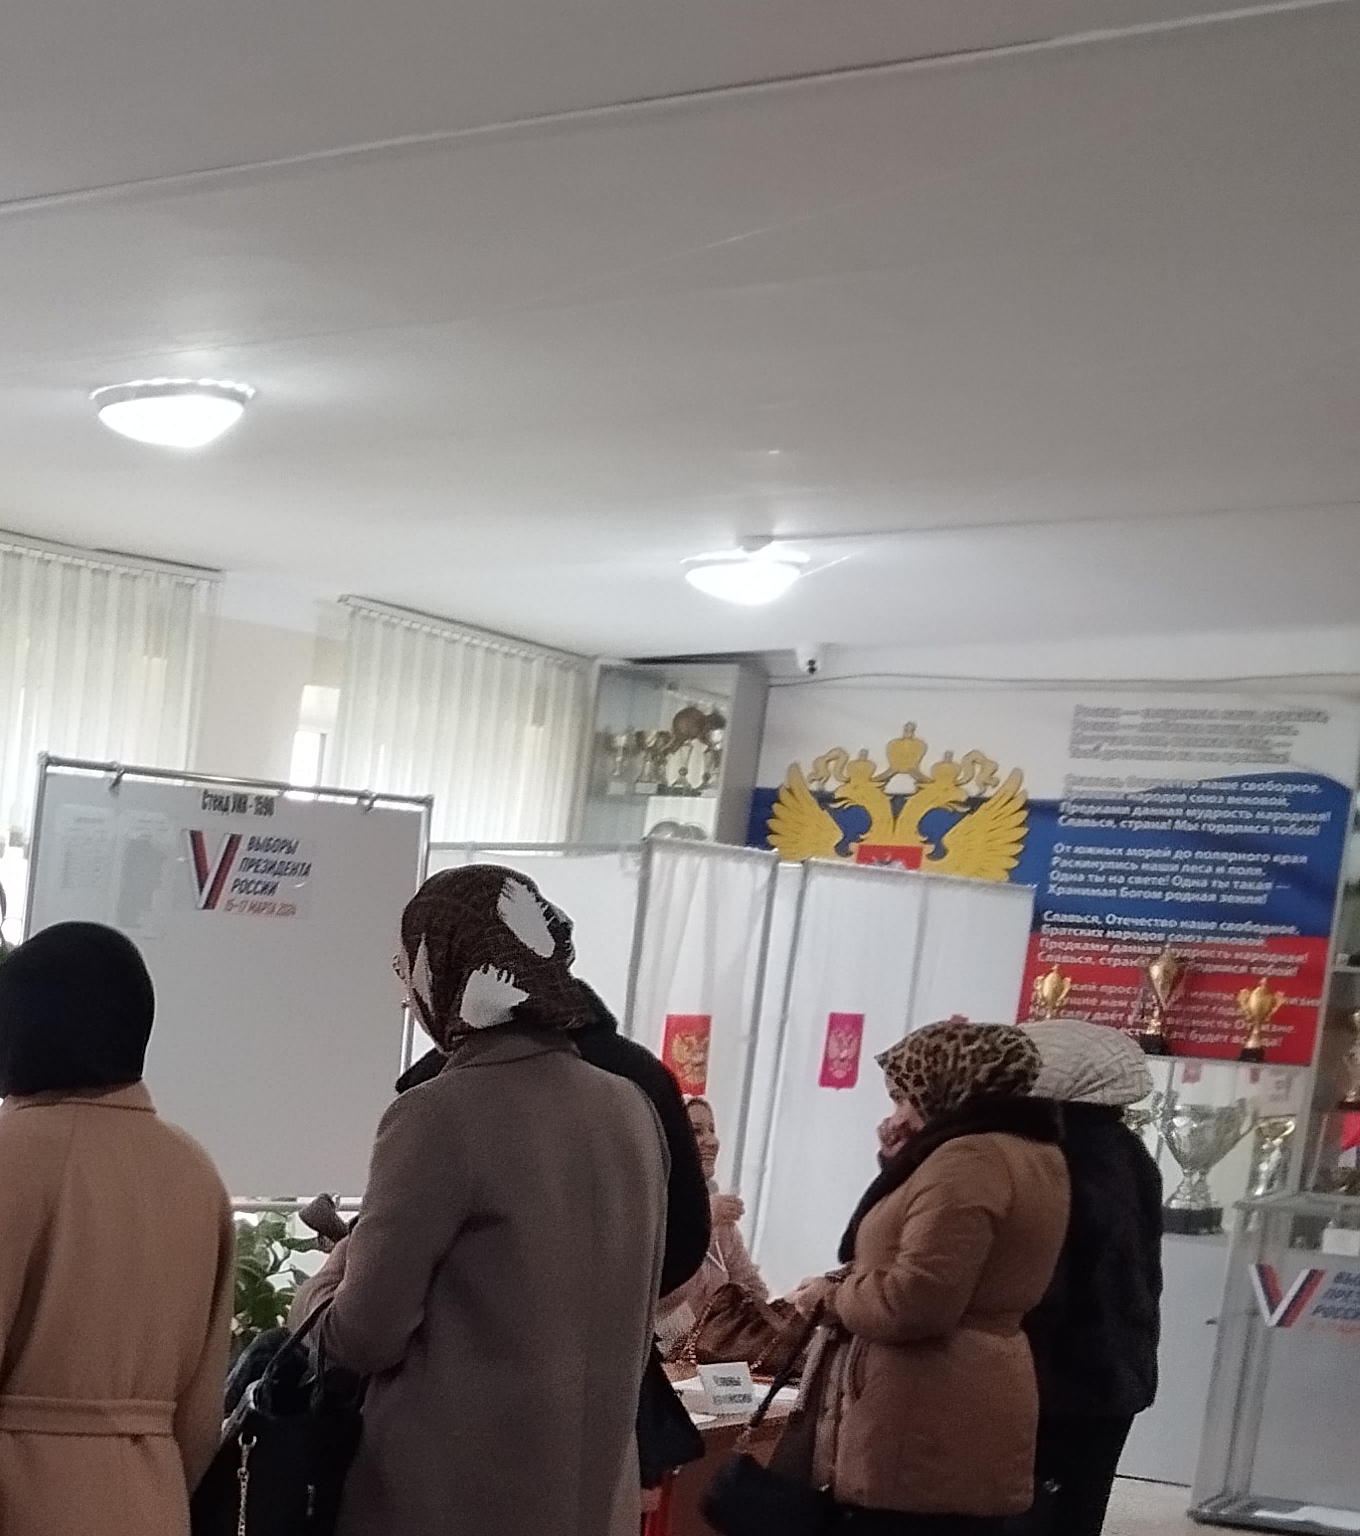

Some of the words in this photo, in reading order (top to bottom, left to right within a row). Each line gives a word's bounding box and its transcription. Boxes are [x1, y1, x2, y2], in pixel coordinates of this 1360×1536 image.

[247, 836, 300, 855] ВЫБОРЫ
[238, 857, 312, 877] ПРЕЗИДЕНТА
[231, 878, 280, 896] РОССИИ
